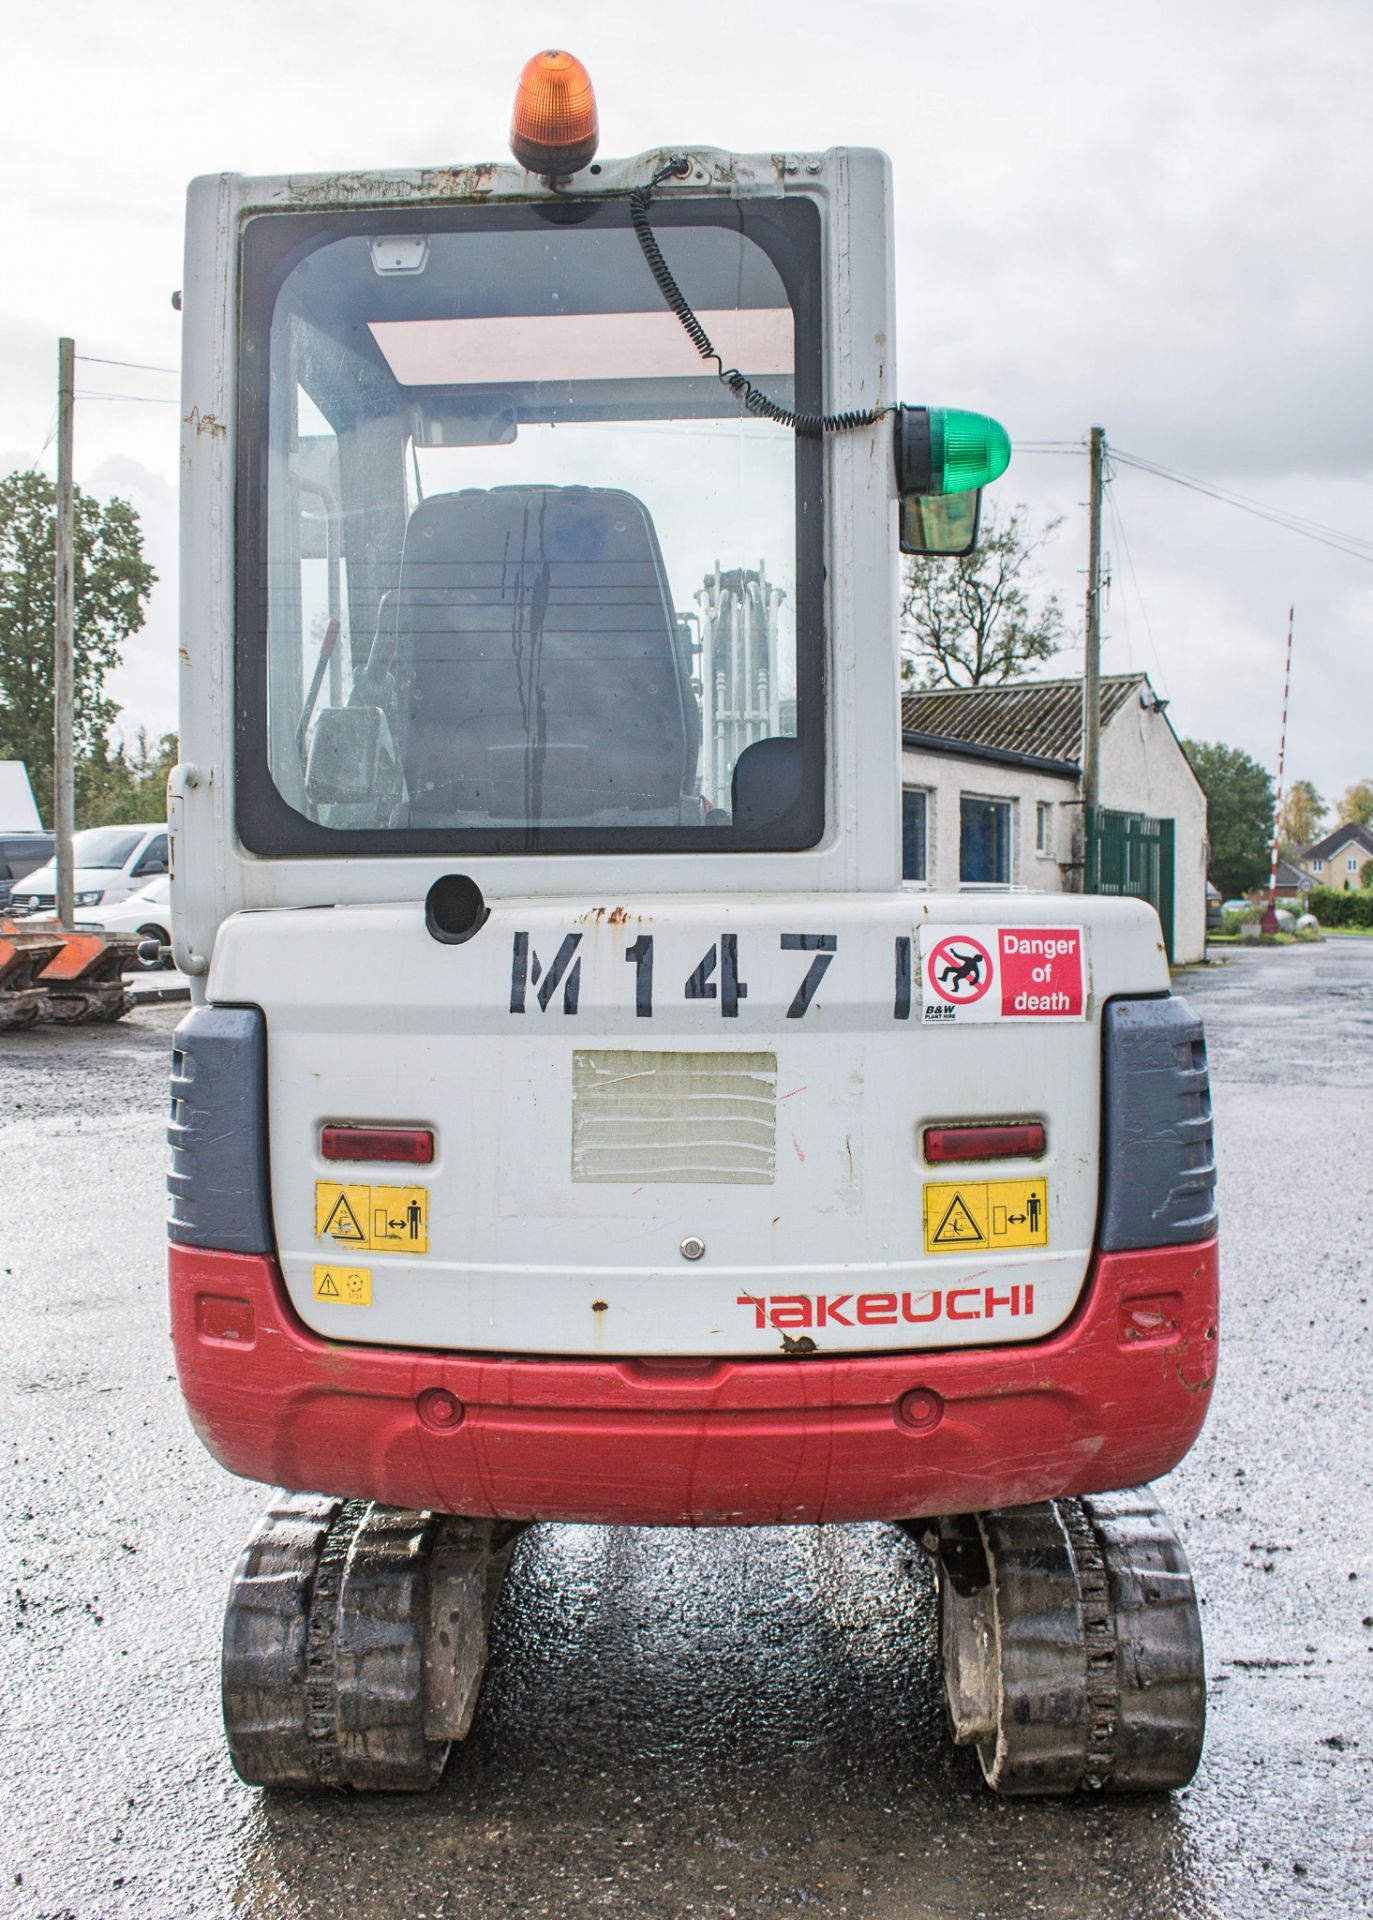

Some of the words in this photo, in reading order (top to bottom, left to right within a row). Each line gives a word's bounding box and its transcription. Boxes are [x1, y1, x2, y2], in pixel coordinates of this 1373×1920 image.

[1003, 935, 1076, 959] Danger
[1031, 964, 1053, 983] of
[926, 1005, 955, 1014] B&W
[1014, 992, 1070, 1011] death
